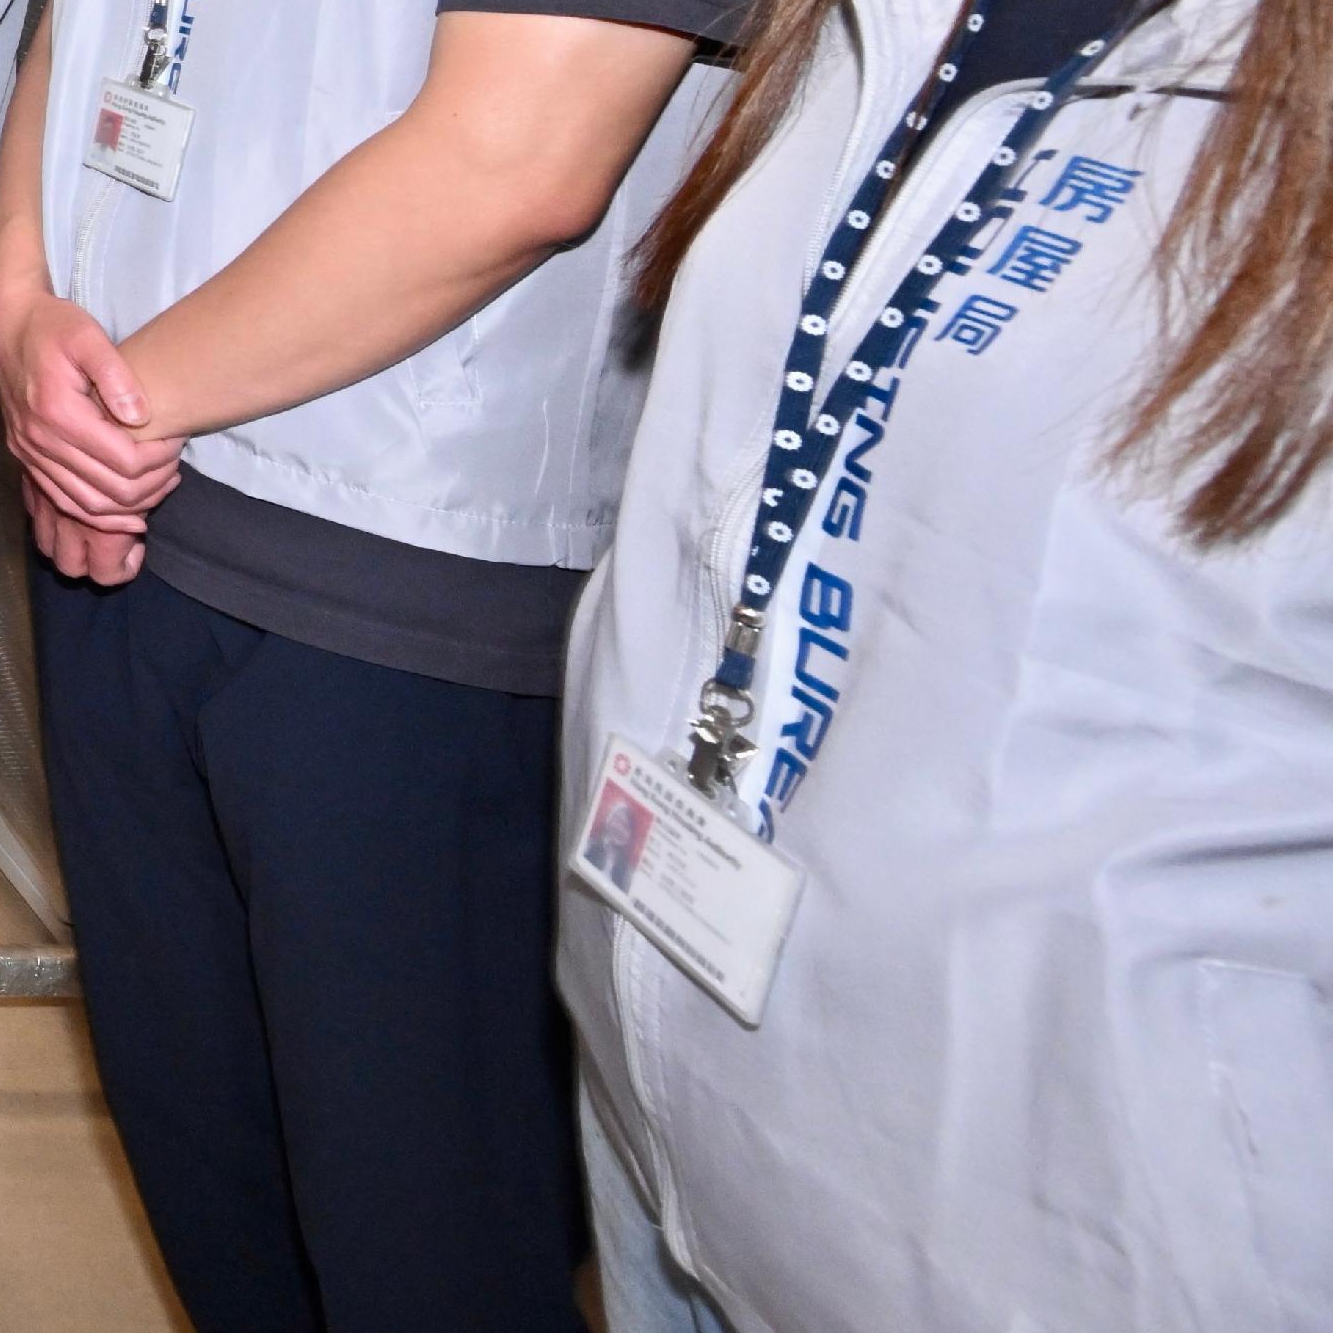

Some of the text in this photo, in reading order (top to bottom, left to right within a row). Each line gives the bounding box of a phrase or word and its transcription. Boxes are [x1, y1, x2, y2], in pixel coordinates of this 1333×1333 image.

[934, 155, 1145, 356] 房屋局
[756, 561, 855, 846] BUREA
